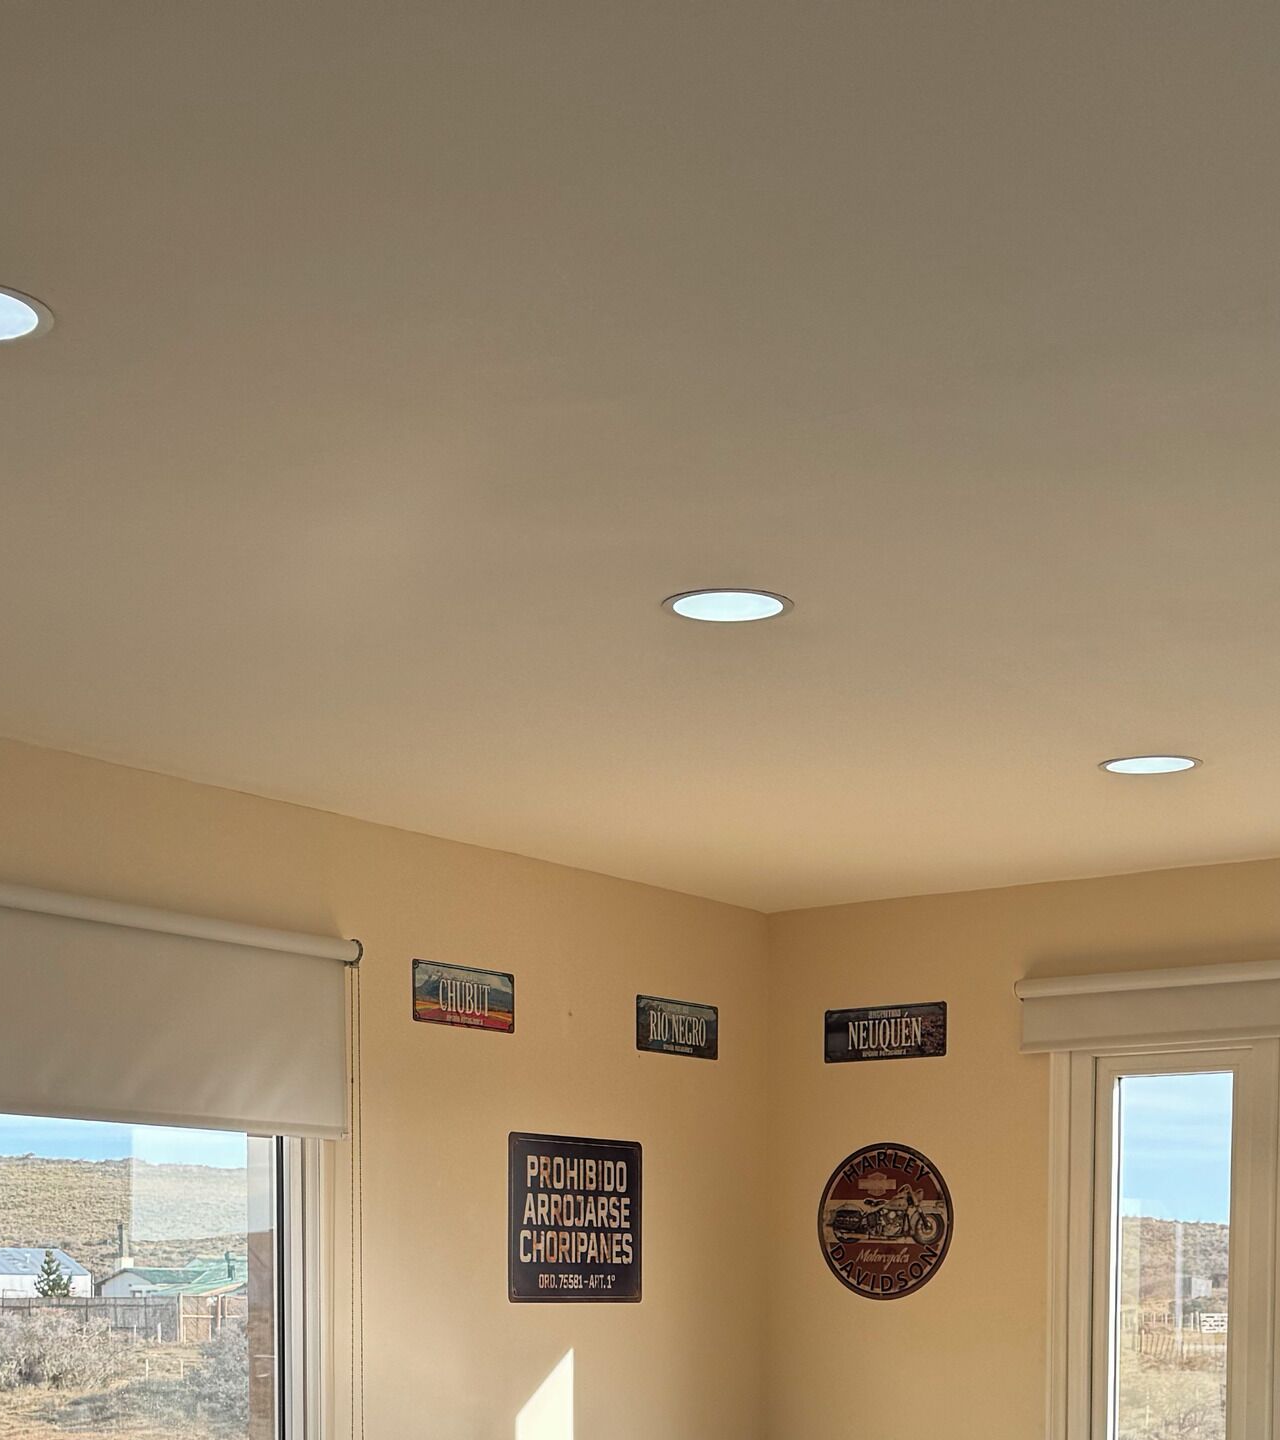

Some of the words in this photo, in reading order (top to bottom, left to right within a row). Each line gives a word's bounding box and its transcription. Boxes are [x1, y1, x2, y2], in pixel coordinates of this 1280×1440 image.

[439, 979, 491, 1017] CHUBUT
[649, 1005, 669, 1042] RÍO
[671, 1014, 706, 1047] NEGRO
[848, 1011, 922, 1052] NEUQUÉN
[526, 1155, 627, 1193] PROHIBIDO
[842, 1151, 931, 1184] HARLEY
[522, 1192, 631, 1229] ARROJARSE
[520, 1229, 633, 1265] CHORIPANES
[830, 1242, 938, 1292] DAVIDSON
